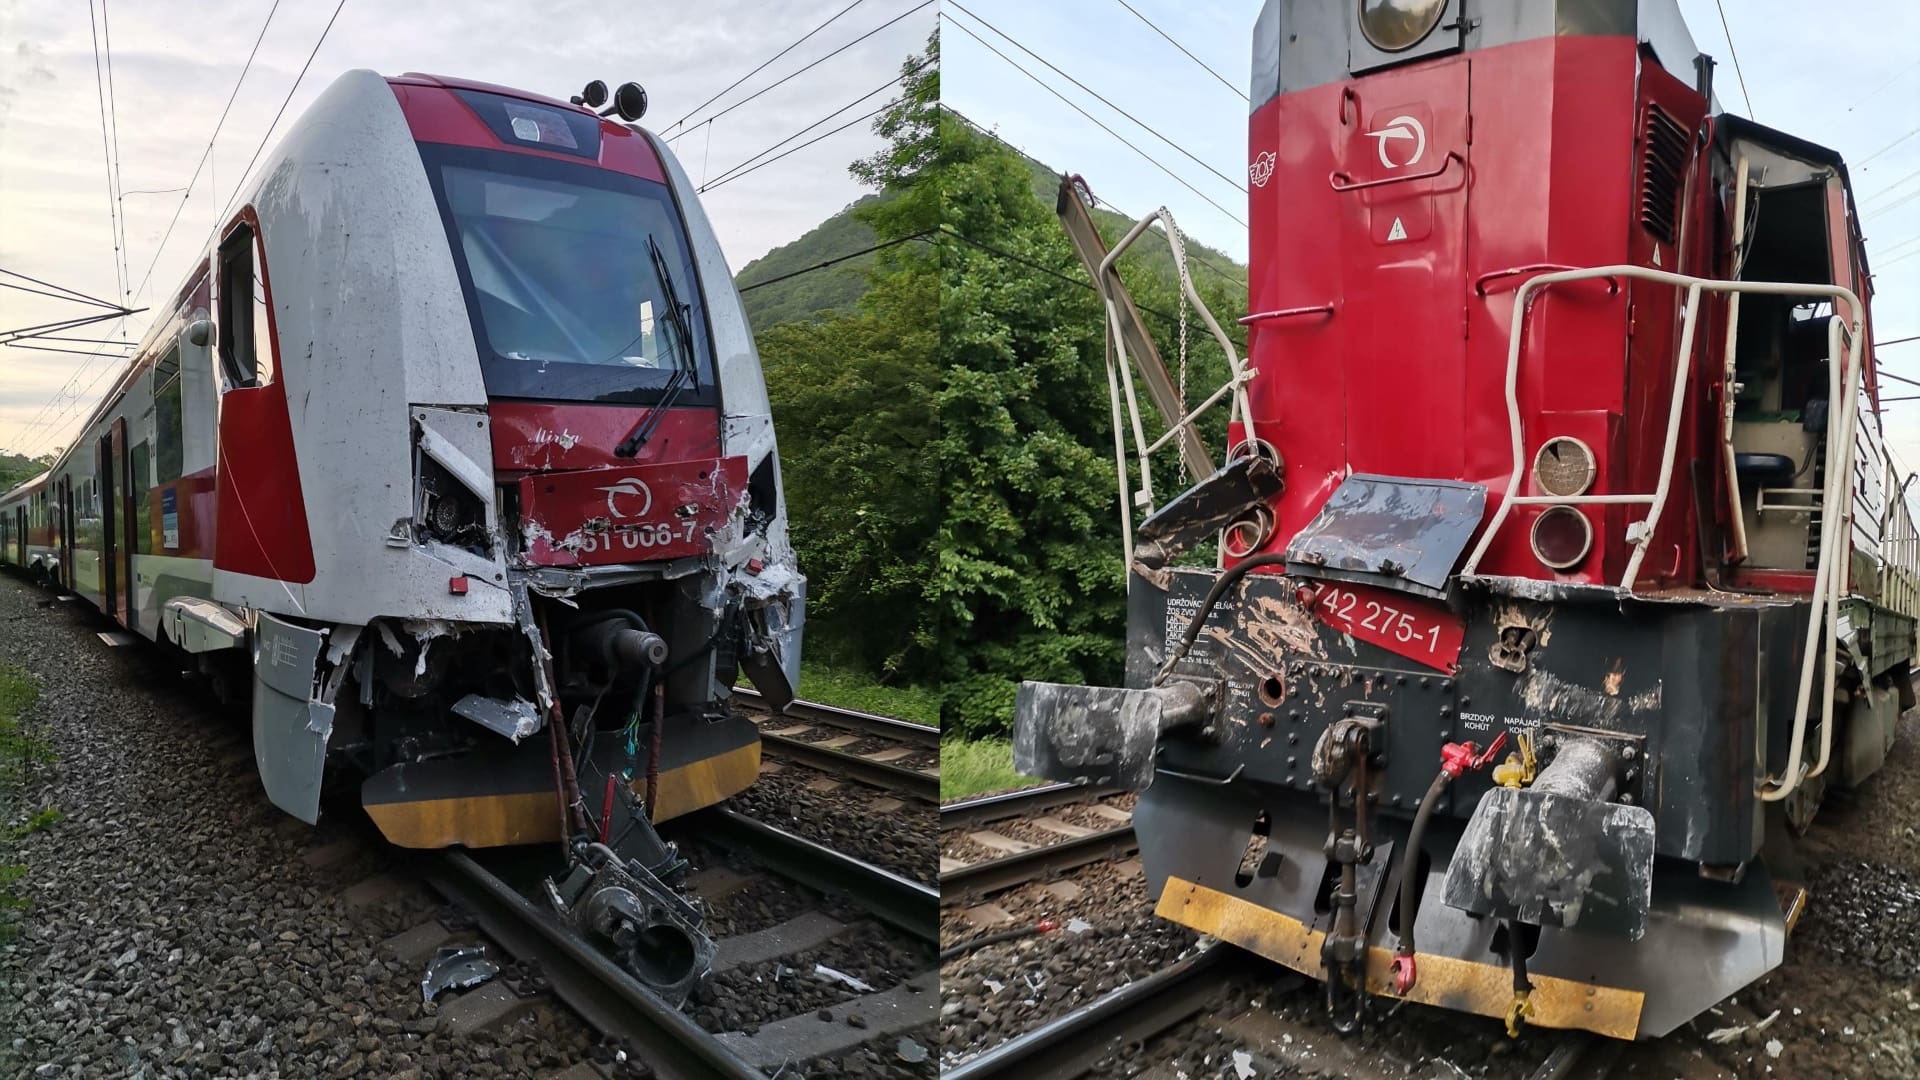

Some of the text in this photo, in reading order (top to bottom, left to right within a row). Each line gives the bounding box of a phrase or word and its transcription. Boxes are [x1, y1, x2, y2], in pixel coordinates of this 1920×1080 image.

[622, 520, 697, 549] 006-7
[1314, 582, 1441, 653] 742 275-1
[1460, 712, 1495, 723] BRZDOVÝ
[1504, 716, 1541, 728] NAPÁJACÍ
[1464, 722, 1490, 731] KOHÚT
[1509, 726, 1529, 735] KOH
